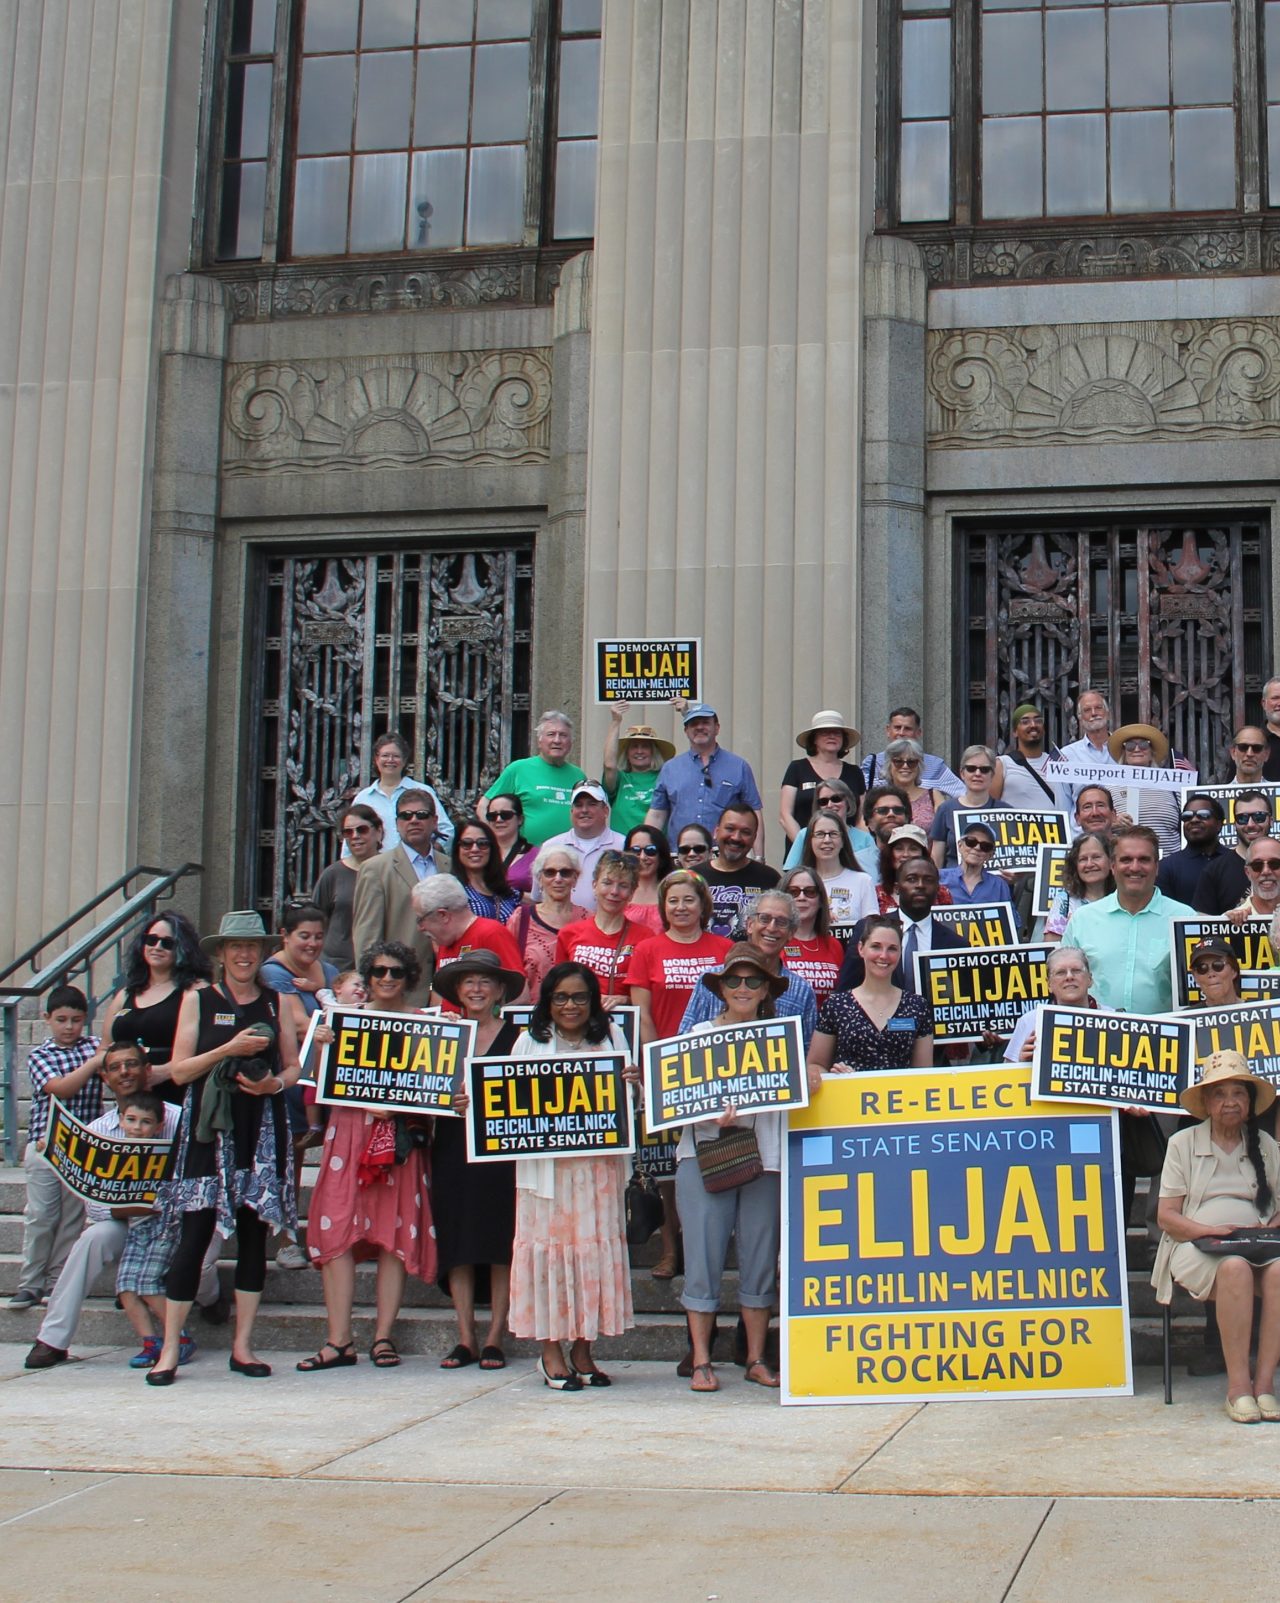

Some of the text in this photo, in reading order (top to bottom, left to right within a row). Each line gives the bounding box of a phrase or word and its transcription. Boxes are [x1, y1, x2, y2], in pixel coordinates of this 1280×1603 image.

[619, 644, 676, 652] DEMOCRAT
[605, 652, 690, 678] ELIJAH
[606, 678, 690, 689] REICHLIN-MELNICK
[615, 690, 680, 698] STATE SENATE
[1050, 764, 1070, 776] We
[1074, 767, 1126, 780] support
[1132, 769, 1183, 784] ELIJAH
[981, 814, 1043, 822] DEMOCRAT
[932, 911, 982, 922] MOCRAT
[576, 945, 612, 956] MOMS
[663, 958, 698, 966] MOMS
[948, 952, 1026, 968] DEMOCRAT
[787, 961, 821, 969] MOMS
[665, 975, 699, 983] ACTIO
[930, 964, 1049, 1005] ELIJAH
[360, 1018, 441, 1036] DEMOCRAT
[947, 1020, 986, 1034] STATE
[1074, 1016, 1159, 1034] DEMOCRAT
[1196, 1008, 1268, 1028] EMOCRAT
[680, 1027, 764, 1052] DEMOCRAT
[1052, 1026, 1179, 1074] ELIJAH
[337, 1030, 459, 1075] ELIJAH
[661, 1038, 789, 1091] ELIJAH
[336, 1066, 454, 1092] REICHLIN-MELNICK
[504, 1061, 592, 1076] DEMOCRAT
[1051, 1064, 1176, 1090] REICHLIN-MELNICK
[346, 1085, 438, 1104] STATE SENATE
[483, 1074, 616, 1118] ELIJAH
[662, 1072, 790, 1106] REICHLIN-MELNICK
[860, 1082, 1032, 1115] RE-ELECT
[1064, 1081, 1163, 1102] STATE SENATE
[676, 1090, 777, 1116] STATE SENATE
[486, 1113, 616, 1136] REICHLIN-MELNICK
[55, 1120, 168, 1180] ELIJAH
[72, 1123, 152, 1154] DEMOCRAT
[501, 1132, 604, 1150] STATE SENATE
[841, 1129, 1056, 1160] STATE SENATOR
[59, 1164, 143, 1200] STATE SENATE
[803, 1164, 1105, 1262] ELIJAH
[803, 1267, 1109, 1308] REICHLIN-MELNICK
[826, 1317, 1093, 1352] FIGHTING FOR
[856, 1351, 1064, 1384] ROCKLAND
